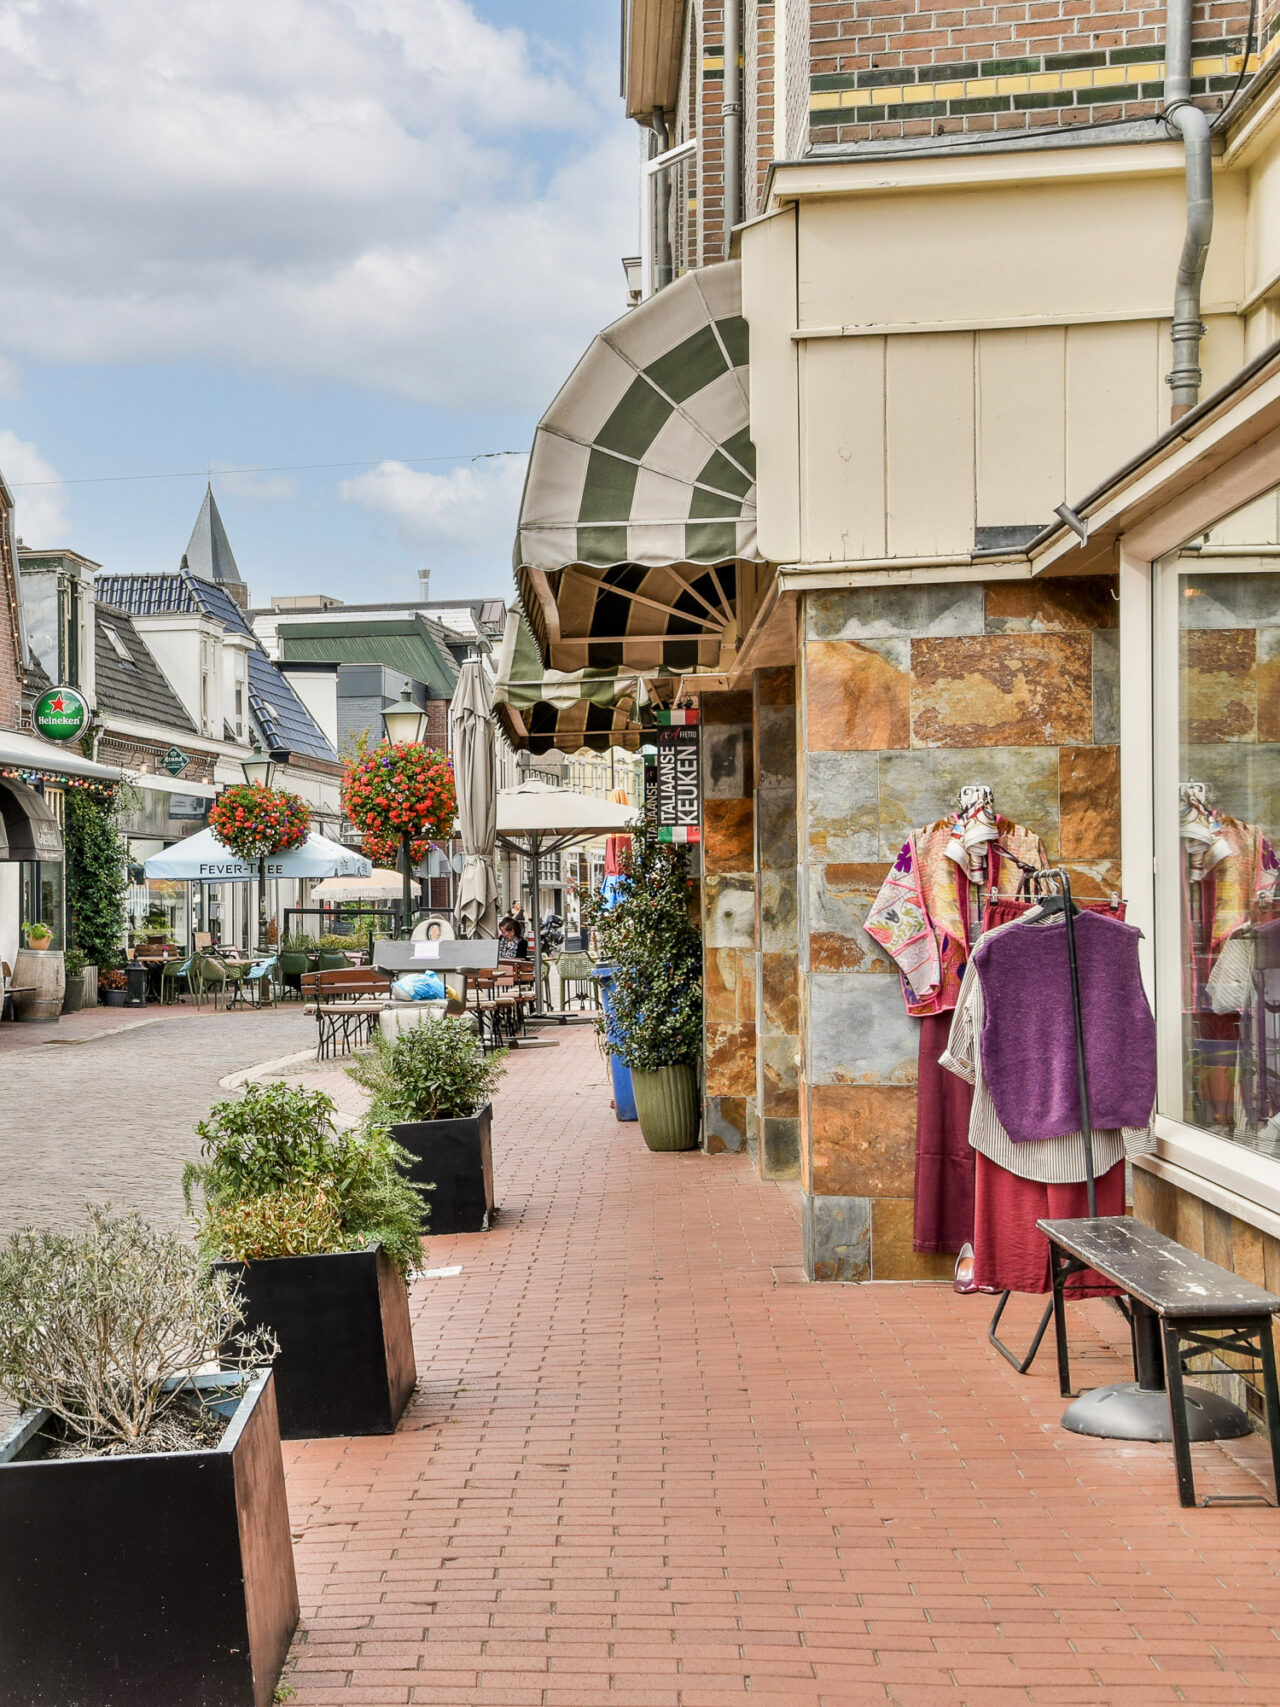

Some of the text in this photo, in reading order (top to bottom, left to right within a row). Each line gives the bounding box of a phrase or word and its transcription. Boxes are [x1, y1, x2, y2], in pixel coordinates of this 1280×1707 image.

[38, 715, 81, 725] Heineken
[660, 746, 676, 824] ITALIAANSE
[677, 745, 698, 824] KEUKEN
[199, 862, 284, 875] FEVER-TEE
